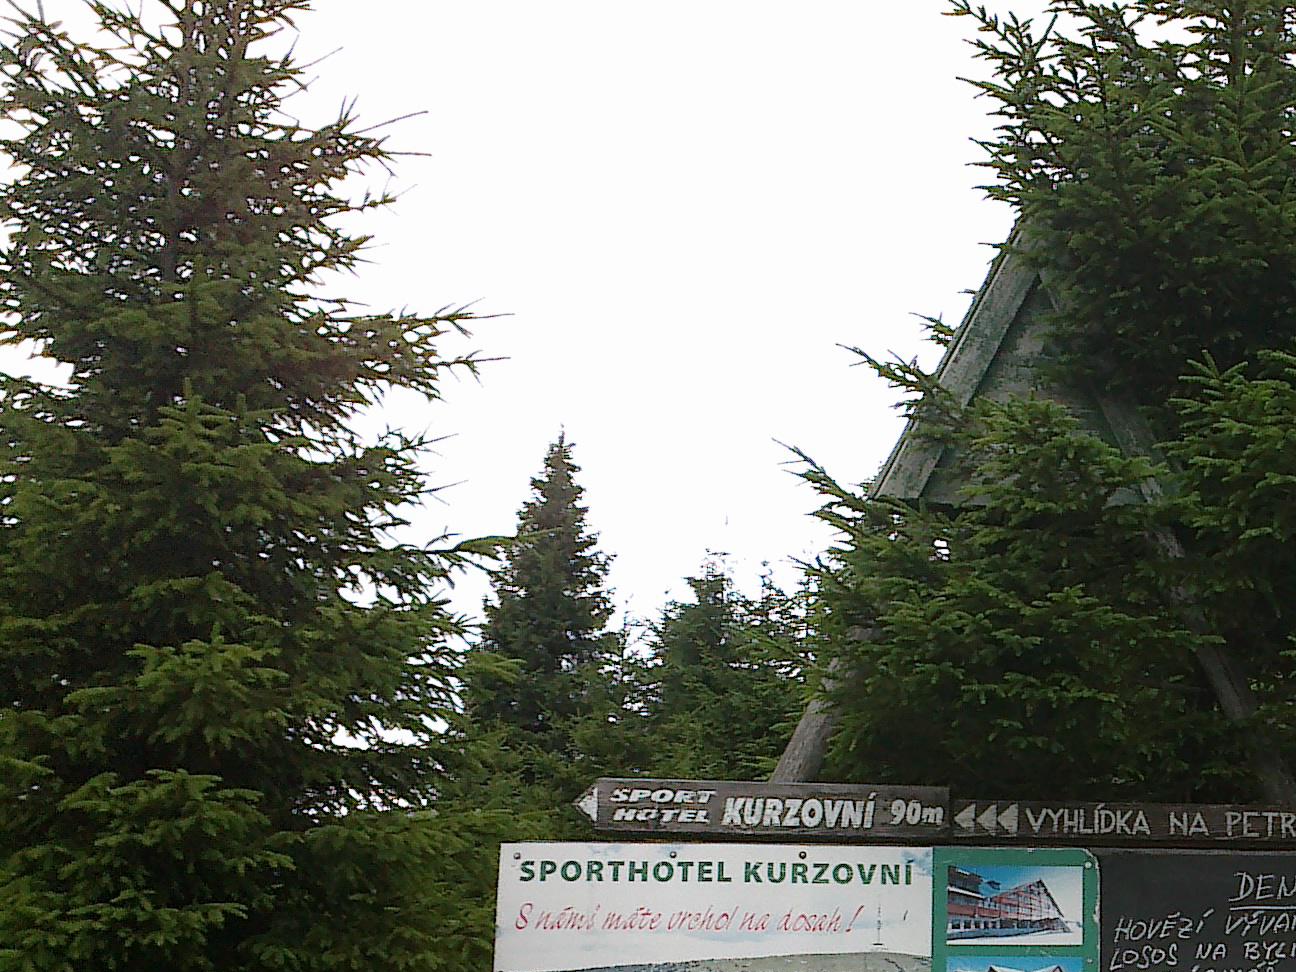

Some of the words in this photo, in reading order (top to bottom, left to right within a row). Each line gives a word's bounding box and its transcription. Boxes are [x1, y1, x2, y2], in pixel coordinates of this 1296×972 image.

[610, 787, 717, 804] SPORT
[612, 808, 711, 824] HOTEL
[721, 792, 876, 829] KURZOVNÍ
[889, 799, 945, 827] 90m
[1026, 804, 1151, 836] VYHLÍDKA
[1169, 810, 1210, 837] NA
[519, 860, 731, 885] SPORTHOTEL
[744, 857, 913, 886] KURZOVNÍ
[515, 902, 533, 930] S
[535, 904, 601, 931] námi
[602, 906, 662, 931] máte
[666, 903, 738, 931] vrchol
[742, 912, 770, 932] na
[1114, 908, 1214, 942] HOVĚZÍ
[1109, 943, 1178, 971] LOSOS
[1195, 943, 1227, 961] NA
